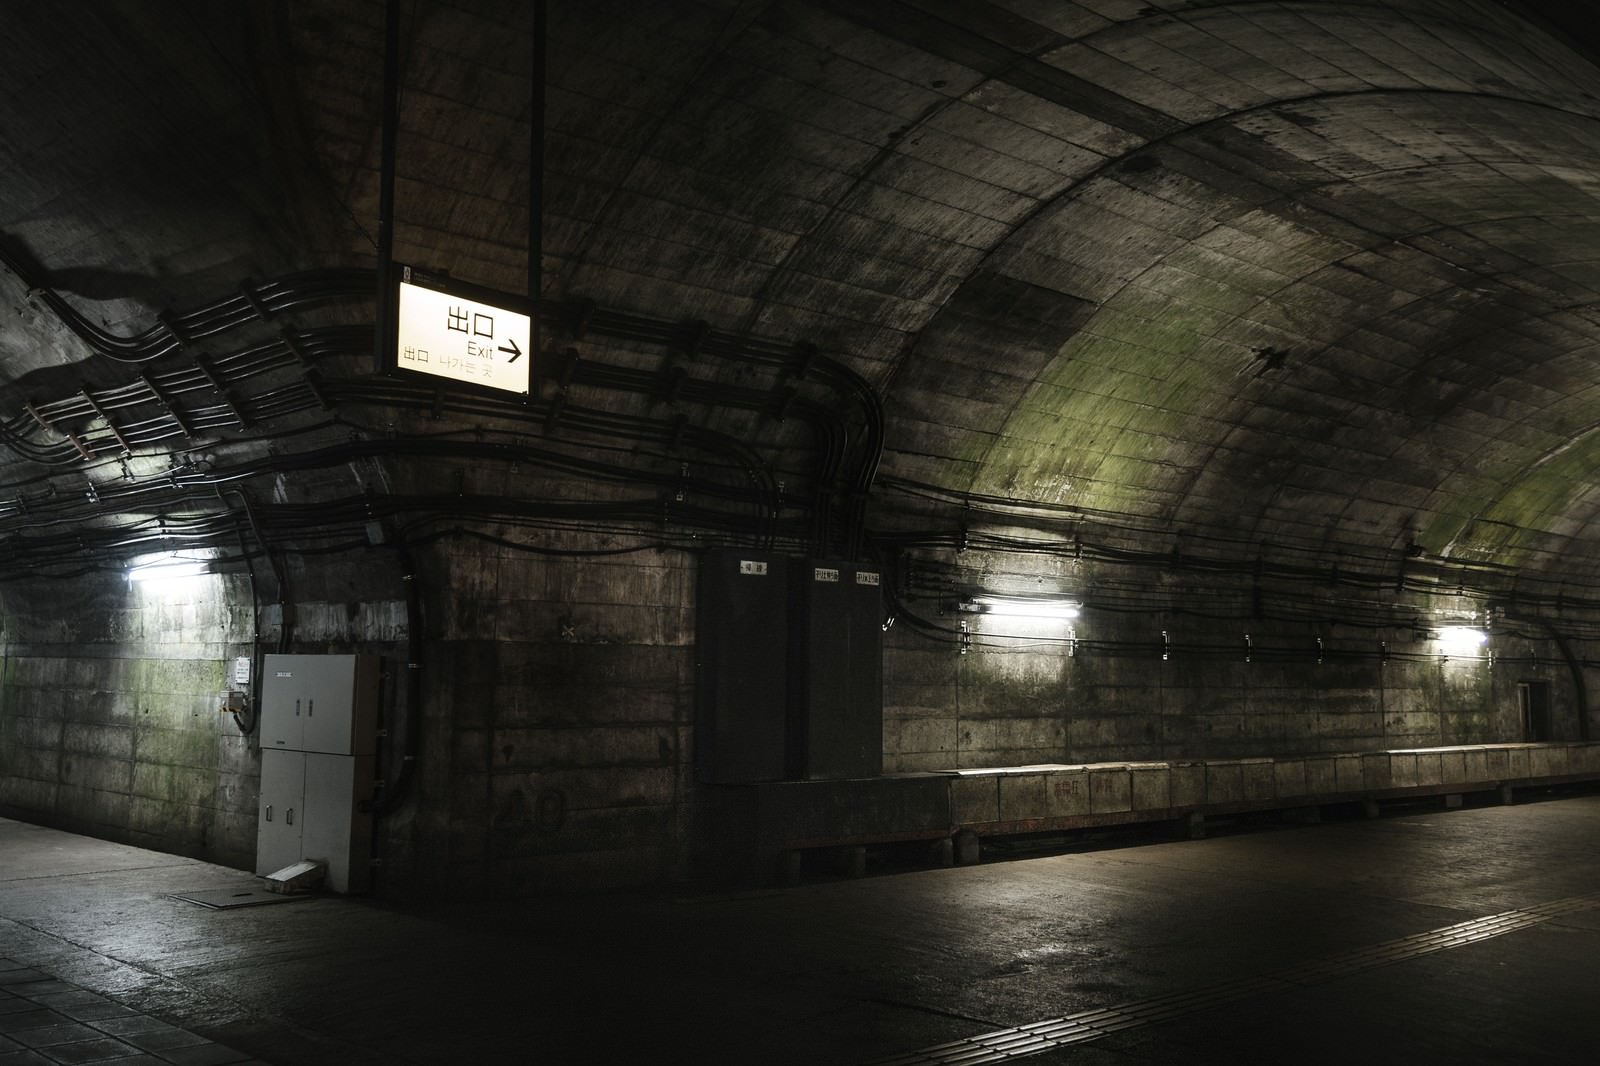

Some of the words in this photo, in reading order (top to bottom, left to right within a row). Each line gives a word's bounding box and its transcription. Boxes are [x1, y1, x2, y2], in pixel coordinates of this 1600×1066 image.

[447, 305, 494, 340] 出口
[403, 345, 429, 363] 出口
[467, 340, 494, 360] Exit
[439, 354, 477, 374] 나가는
